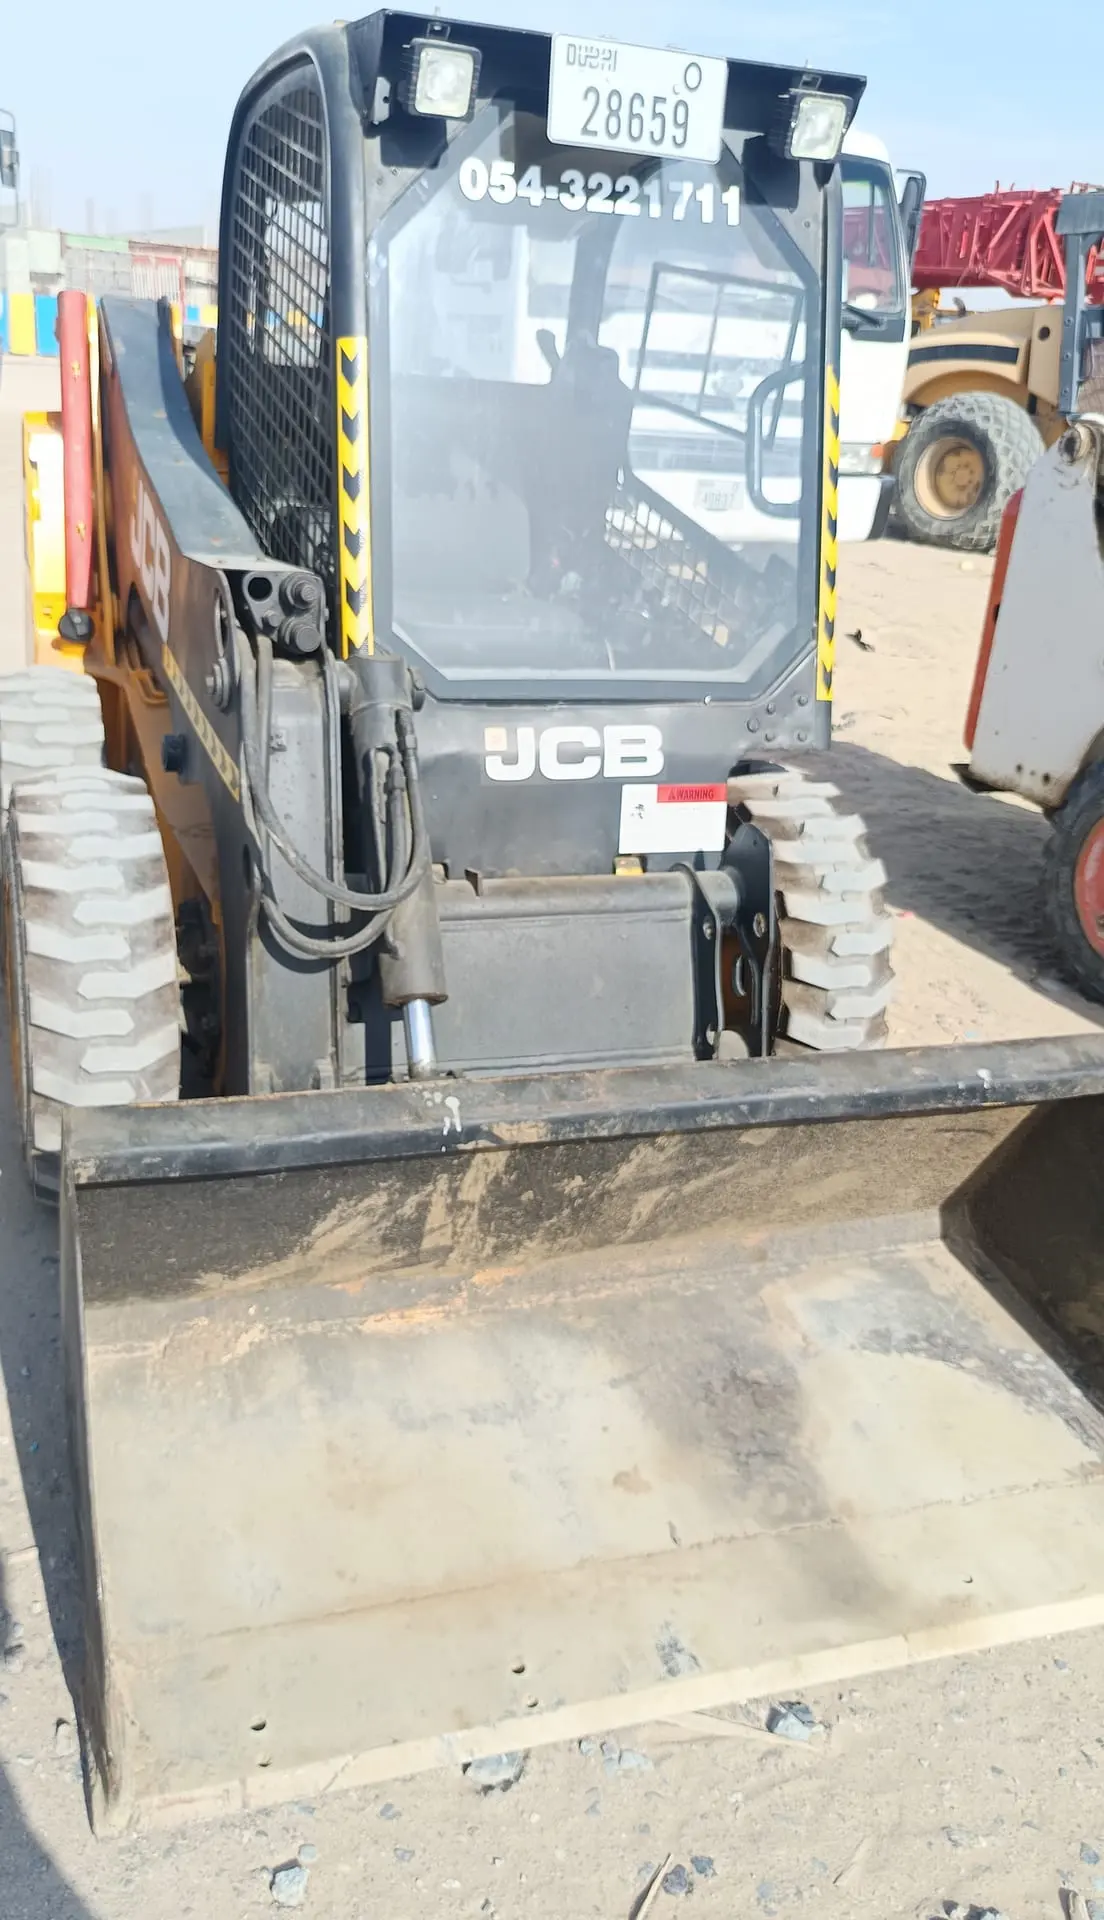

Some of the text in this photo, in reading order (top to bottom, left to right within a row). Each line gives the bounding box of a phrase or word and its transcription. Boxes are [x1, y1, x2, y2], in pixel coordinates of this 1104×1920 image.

[566, 43, 618, 72] DUBAI
[580, 85, 690, 149] 28659
[458, 157, 741, 227] 054-3221711
[130, 479, 171, 645] JCB
[484, 725, 664, 781] JCB
[676, 788, 715, 801] WARNING
